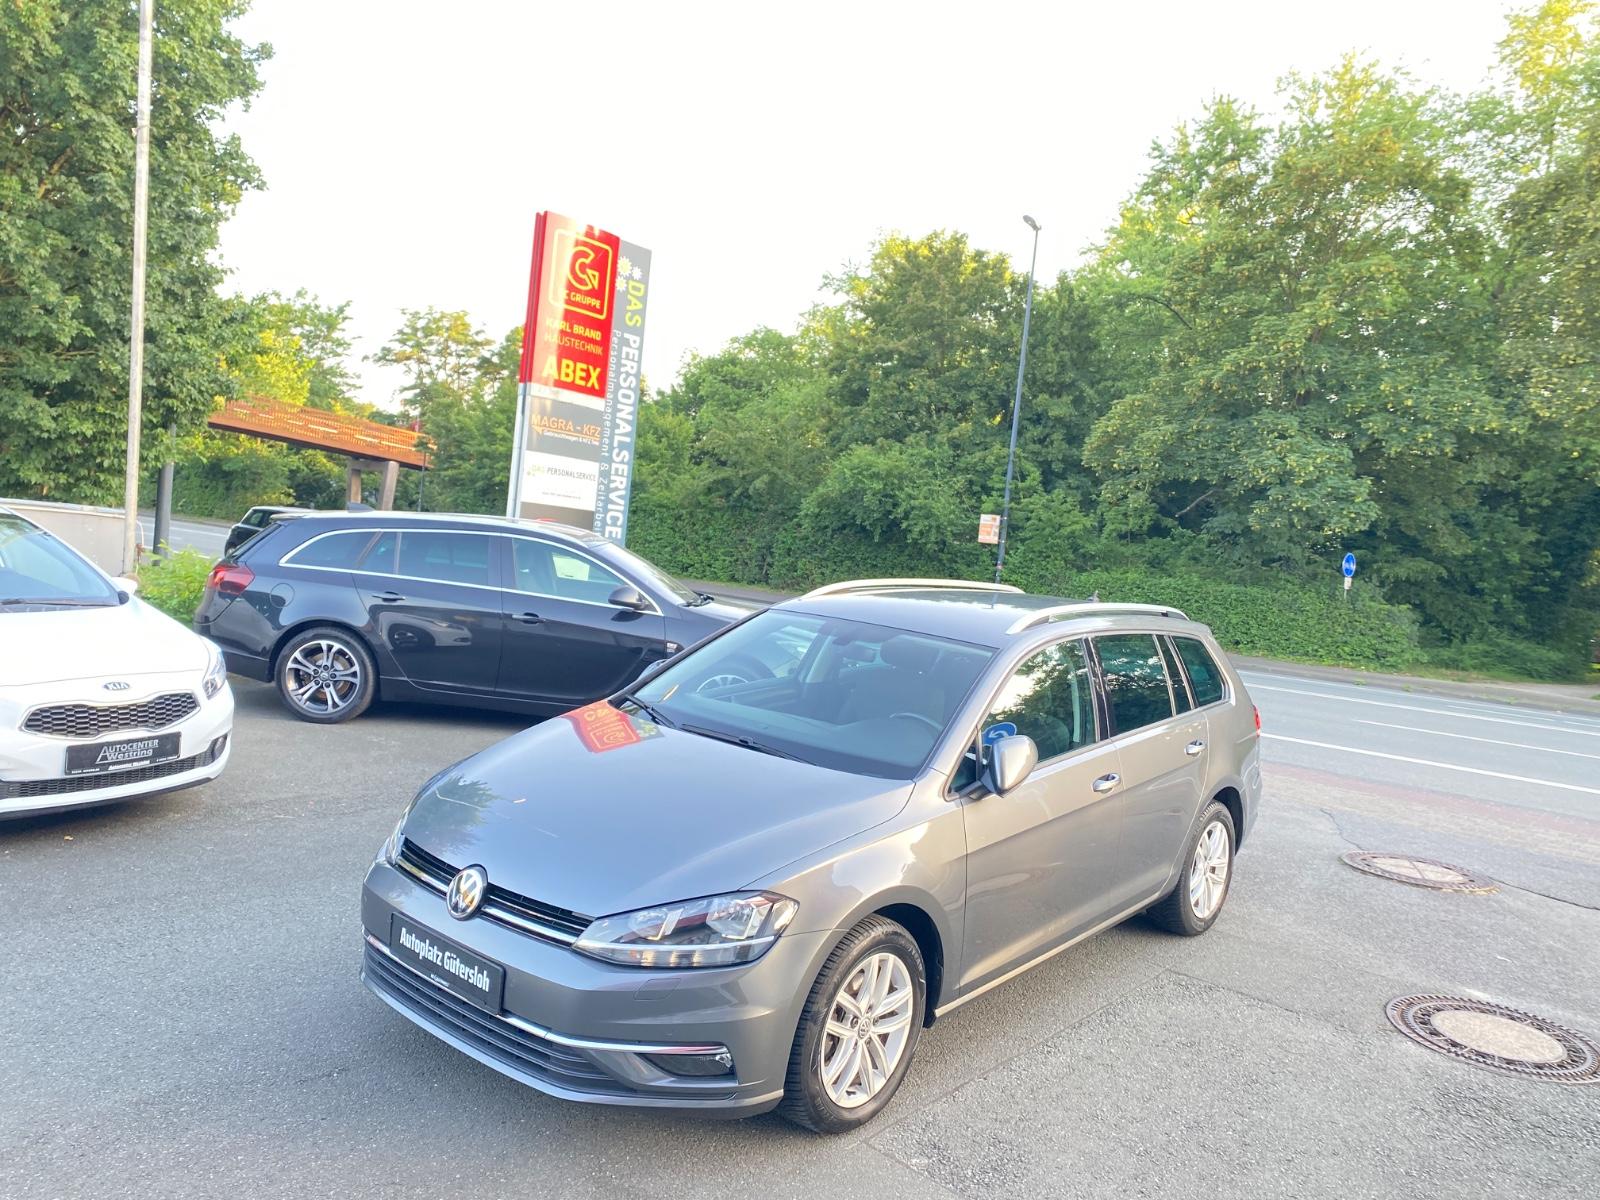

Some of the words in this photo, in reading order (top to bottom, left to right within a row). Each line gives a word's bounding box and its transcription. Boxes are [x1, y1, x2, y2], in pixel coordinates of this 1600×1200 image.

[570, 291, 601, 309] GRUPPE
[625, 280, 645, 329] DAS
[545, 317, 571, 333] KARL
[573, 323, 602, 341] BRAND
[544, 332, 604, 356] HAUSTECHNIK
[542, 354, 601, 390] ABEX
[531, 413, 574, 432] MAGRA
[582, 423, 601, 437] KFZ
[605, 333, 640, 539] PERSONALSERVICE
[106, 681, 130, 691] KIA
[96, 739, 159, 764] AUTOCENTER
[108, 748, 153, 762] Westring
[399, 927, 443, 966] Autoplatz
[443, 951, 491, 993] Gütersloh
